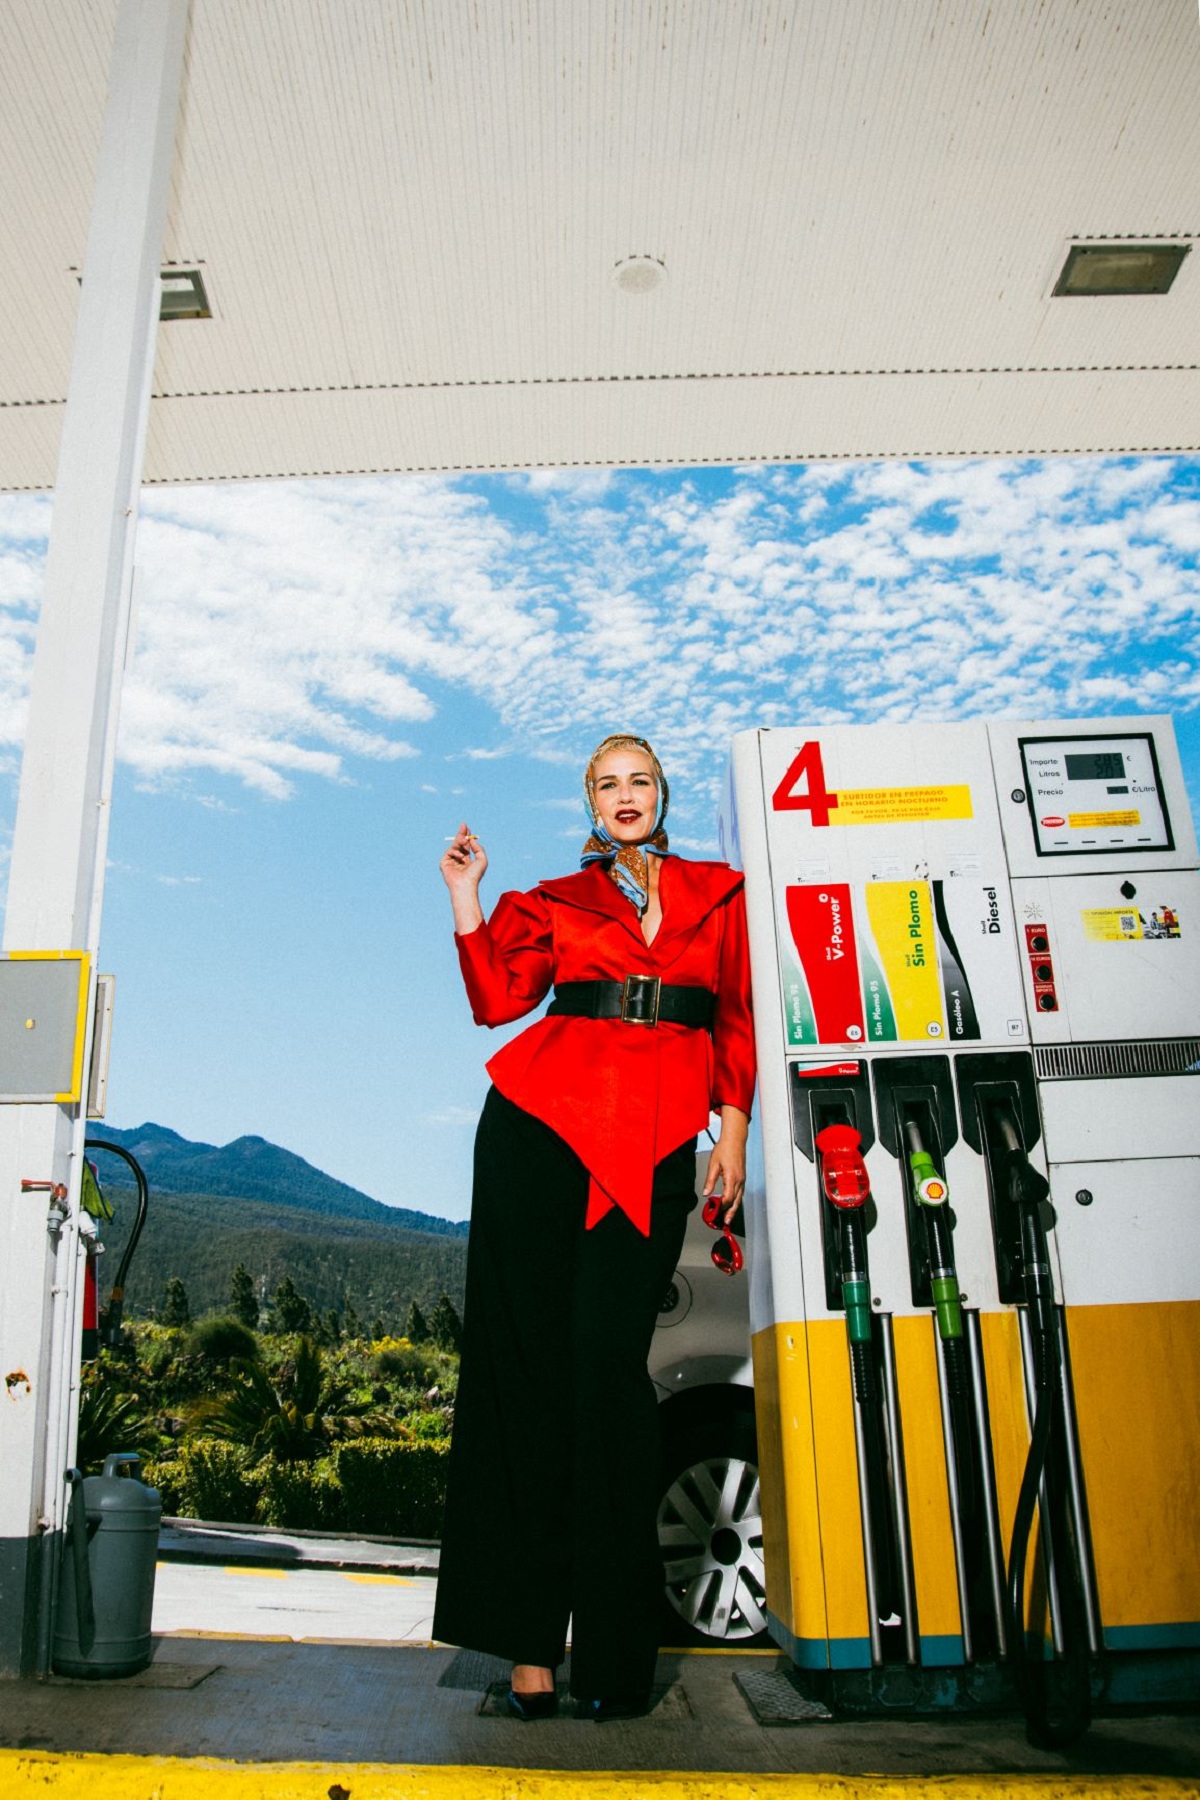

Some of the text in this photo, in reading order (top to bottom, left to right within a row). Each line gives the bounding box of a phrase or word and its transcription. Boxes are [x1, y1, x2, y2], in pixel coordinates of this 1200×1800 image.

[772, 740, 839, 827] 4
[843, 789, 944, 801] SURTIDOR EN PREPAGO
[855, 798, 896, 807] HORARIO
[898, 796, 948, 805] NOCTURNO
[830, 897, 844, 960] V-Power
[908, 890, 925, 967] Sin Plomo
[983, 886, 1001, 934] Diesel
[792, 996, 802, 1024] Plomo
[869, 980, 883, 1036] Sin Plomo 95
[954, 999, 964, 1035] Gasóleo
[793, 1025, 803, 1040] Sin
